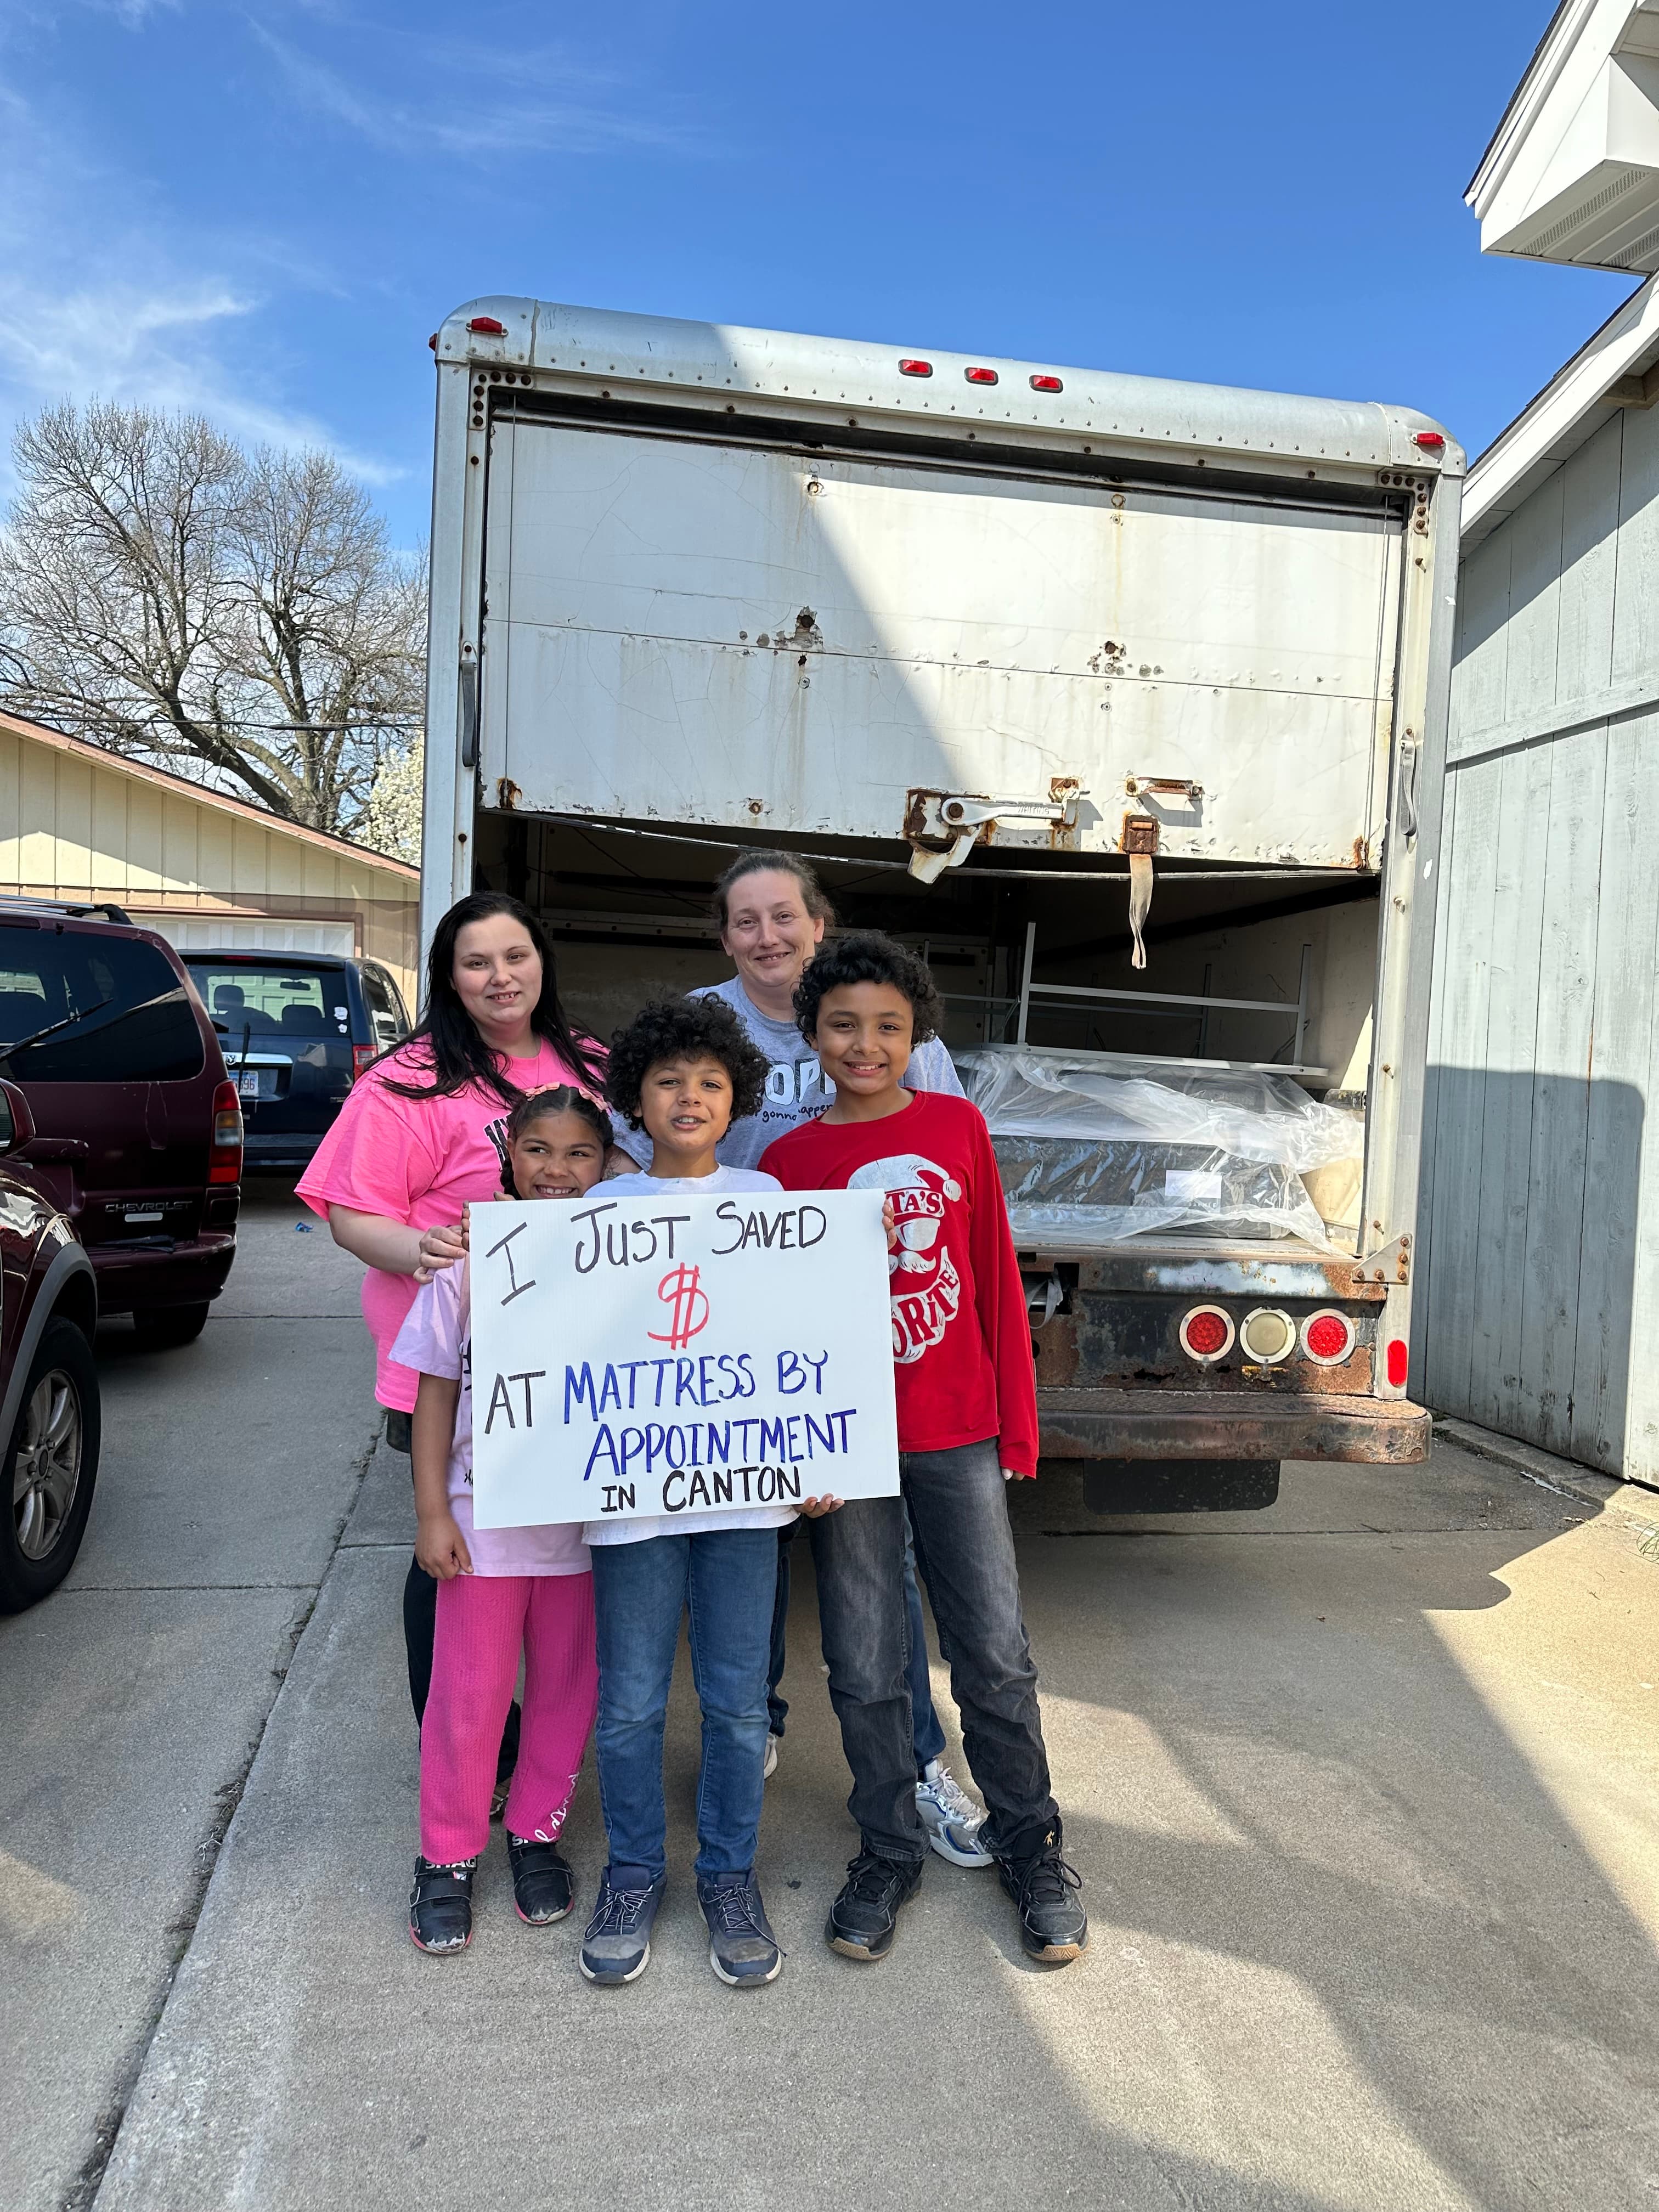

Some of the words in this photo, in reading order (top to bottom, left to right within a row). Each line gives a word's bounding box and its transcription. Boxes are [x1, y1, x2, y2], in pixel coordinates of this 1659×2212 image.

[1017, 806, 1049, 815] WHITING
[105, 1201, 193, 1212] CHEVROLET
[486, 1222, 536, 1306] I
[571, 1202, 691, 1273] JUST
[712, 1201, 827, 1255] SAVED
[647, 1262, 709, 1351] $
[485, 1370, 546, 1435] AT
[564, 1353, 756, 1425] MATTRESS
[777, 1350, 828, 1395] BY
[583, 1408, 857, 1481] APPOINTMENT
[601, 1483, 636, 1513] IN
[662, 1466, 801, 1513] CANTON
